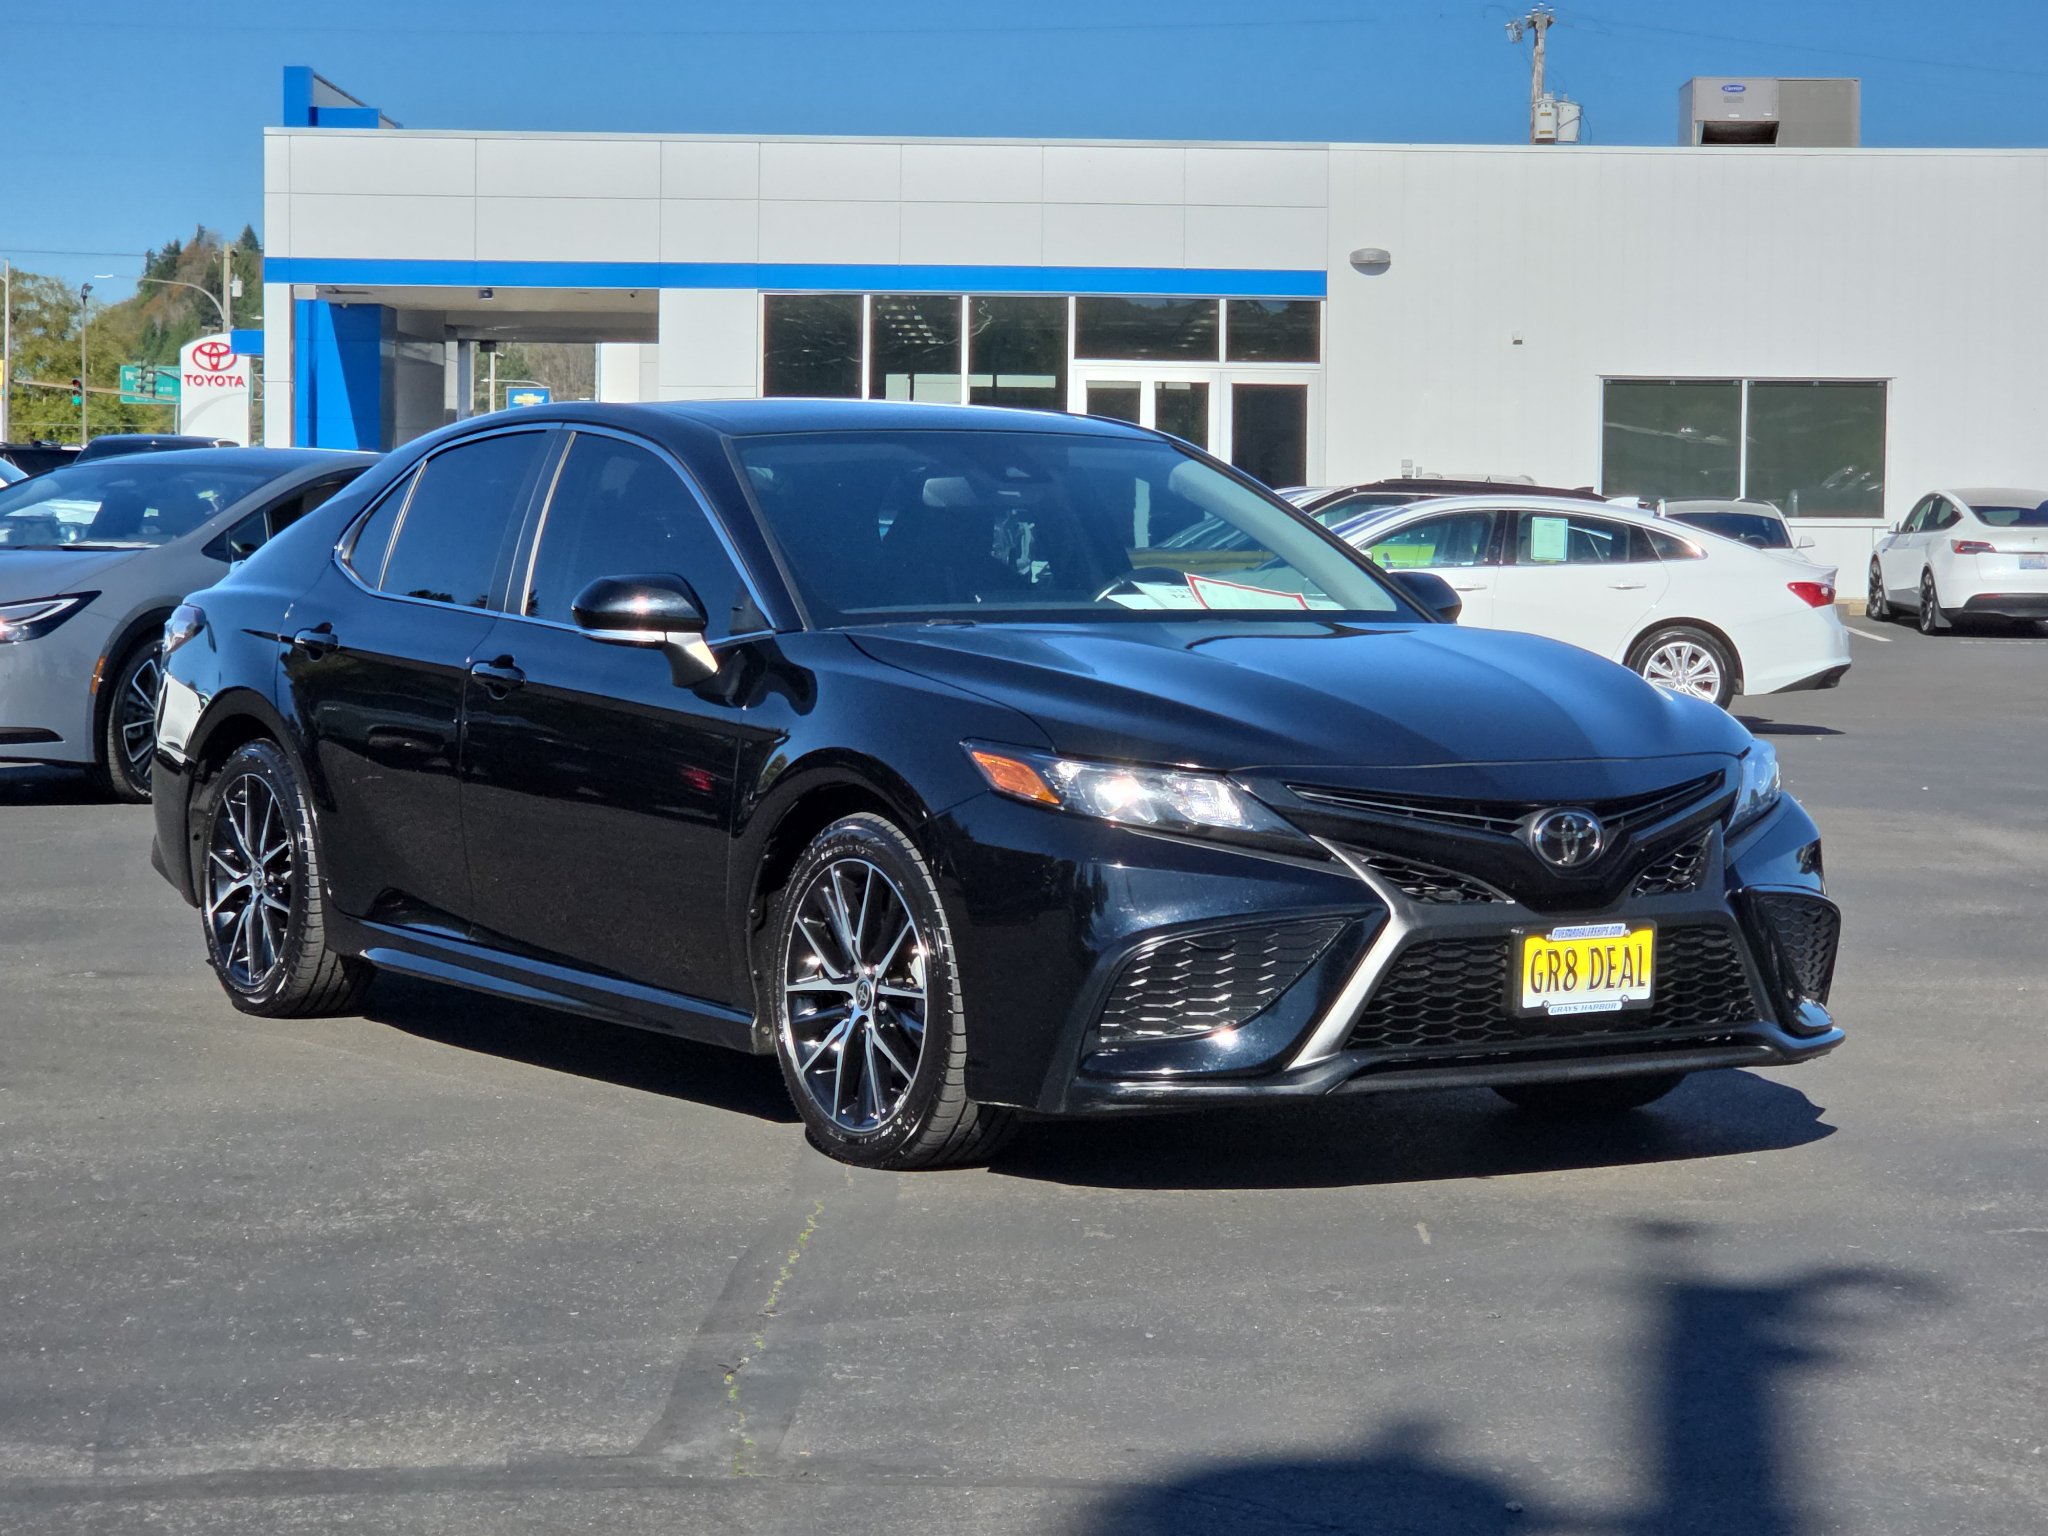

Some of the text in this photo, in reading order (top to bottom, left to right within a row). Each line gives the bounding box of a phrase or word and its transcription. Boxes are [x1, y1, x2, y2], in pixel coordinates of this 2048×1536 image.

[184, 374, 246, 387] TOYOTA
[1530, 944, 1646, 994] GR8 DEAL
[1550, 1002, 1617, 1014] GRAYS HARBOR
